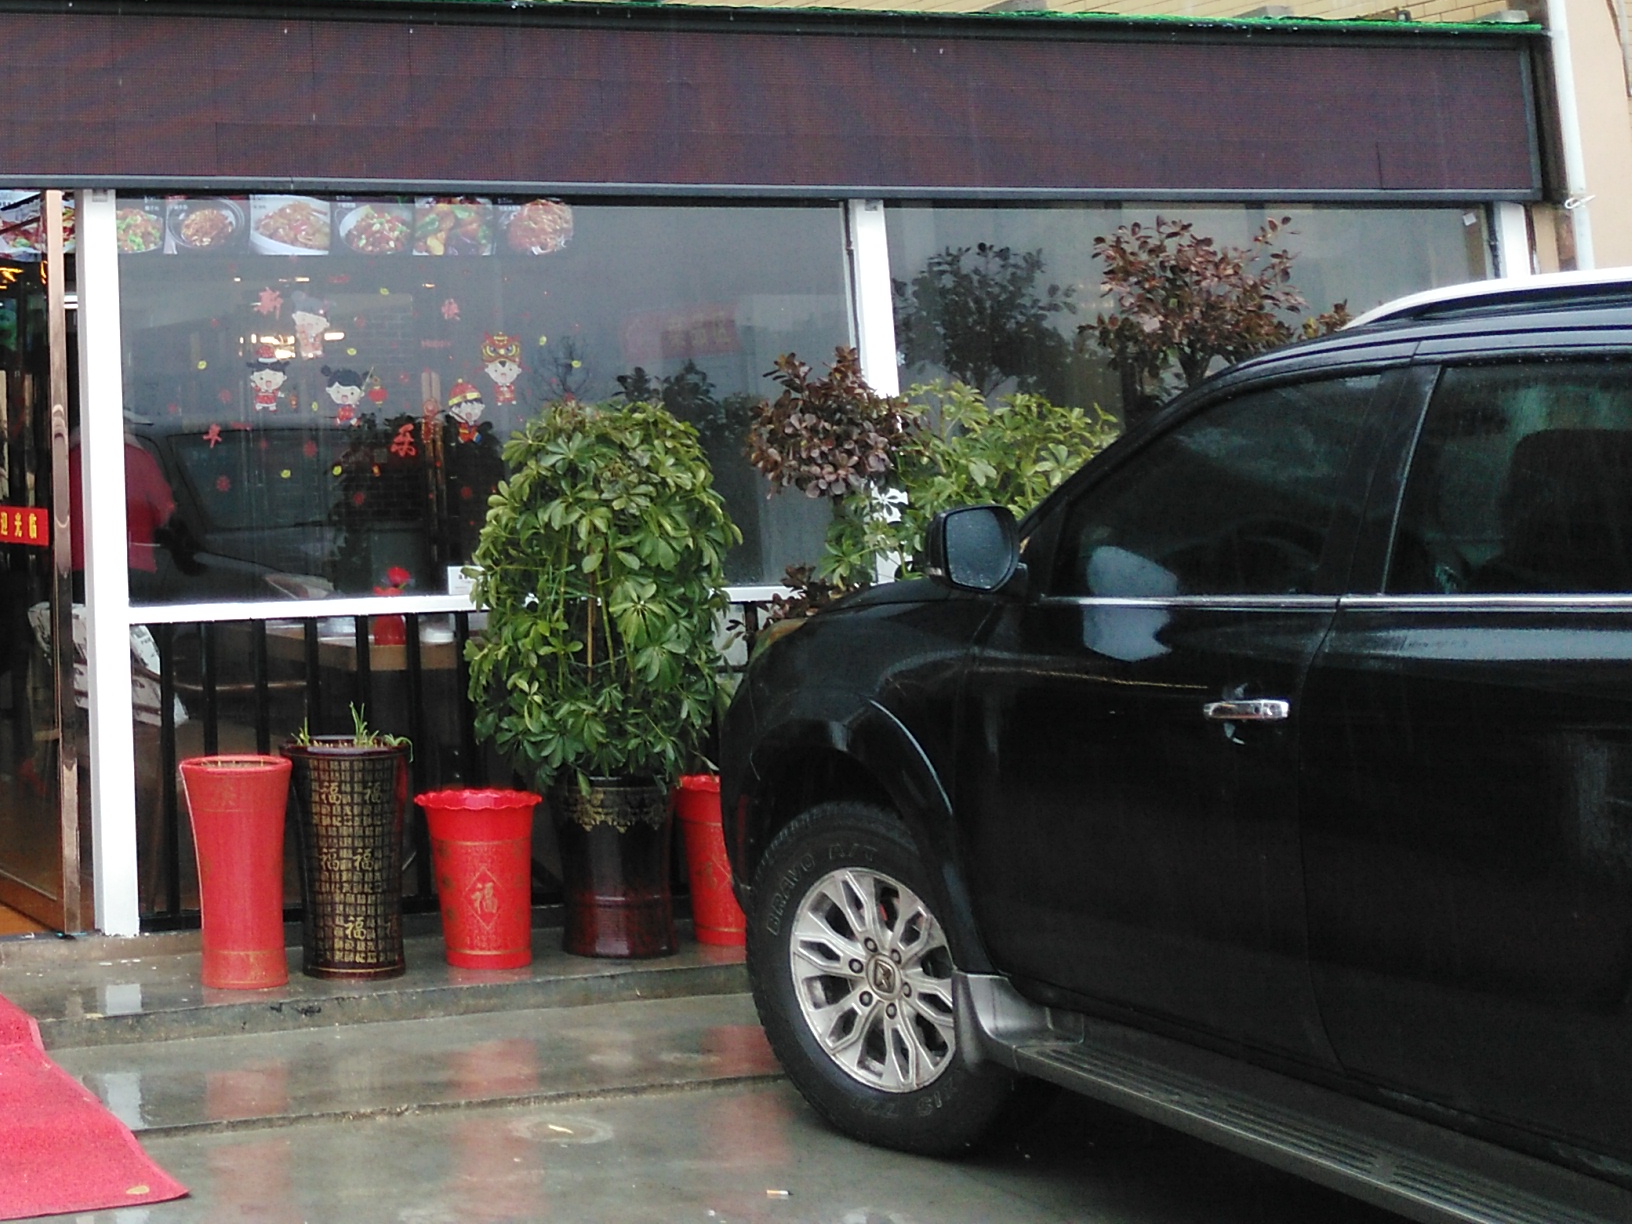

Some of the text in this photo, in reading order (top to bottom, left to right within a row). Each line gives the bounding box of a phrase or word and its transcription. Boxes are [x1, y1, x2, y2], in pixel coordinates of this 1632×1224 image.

[319, 782, 342, 805] 福
[363, 782, 383, 804] 福
[319, 847, 340, 871] 福
[352, 847, 374, 872] 福
[470, 881, 498, 915] 福
[767, 853, 816, 936] BRAVO
[344, 915, 367, 940] 福
